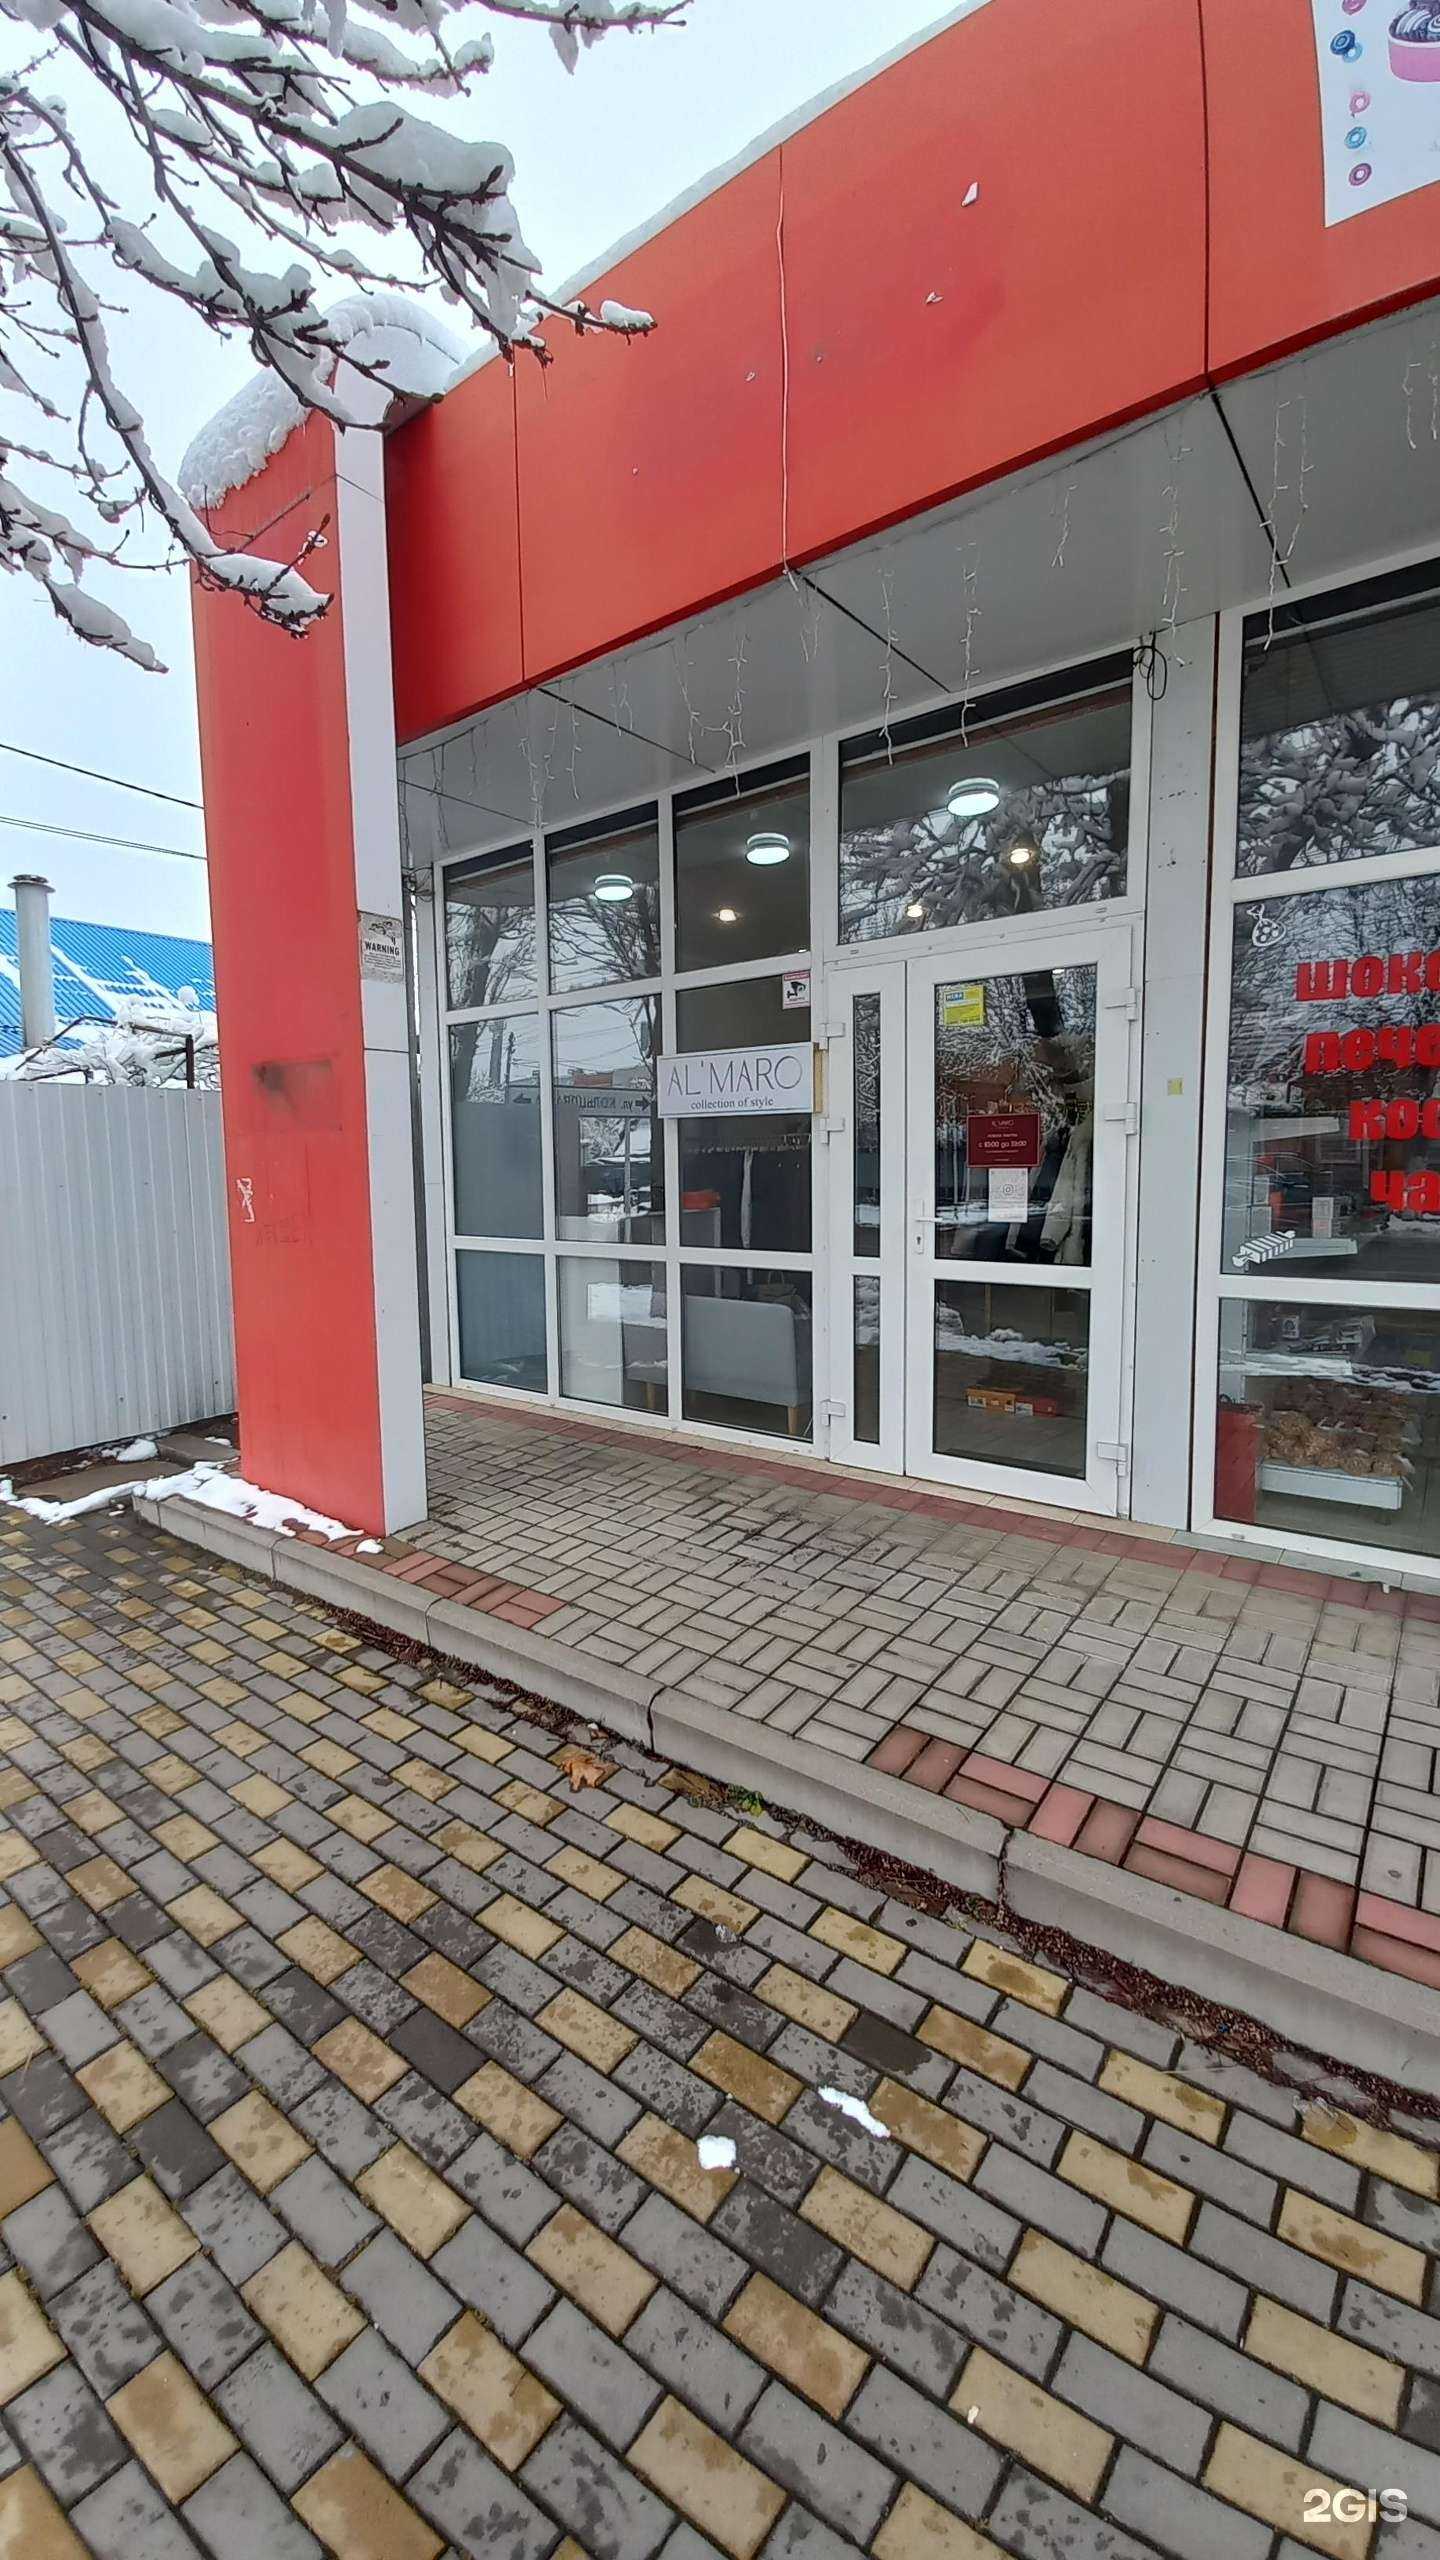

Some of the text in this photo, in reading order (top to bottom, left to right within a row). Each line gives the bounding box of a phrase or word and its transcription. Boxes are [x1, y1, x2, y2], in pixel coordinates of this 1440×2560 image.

[365, 940, 400, 956] WARNING
[668, 1055, 802, 1096] AL'MARO
[690, 1096, 774, 1110] collection of style
